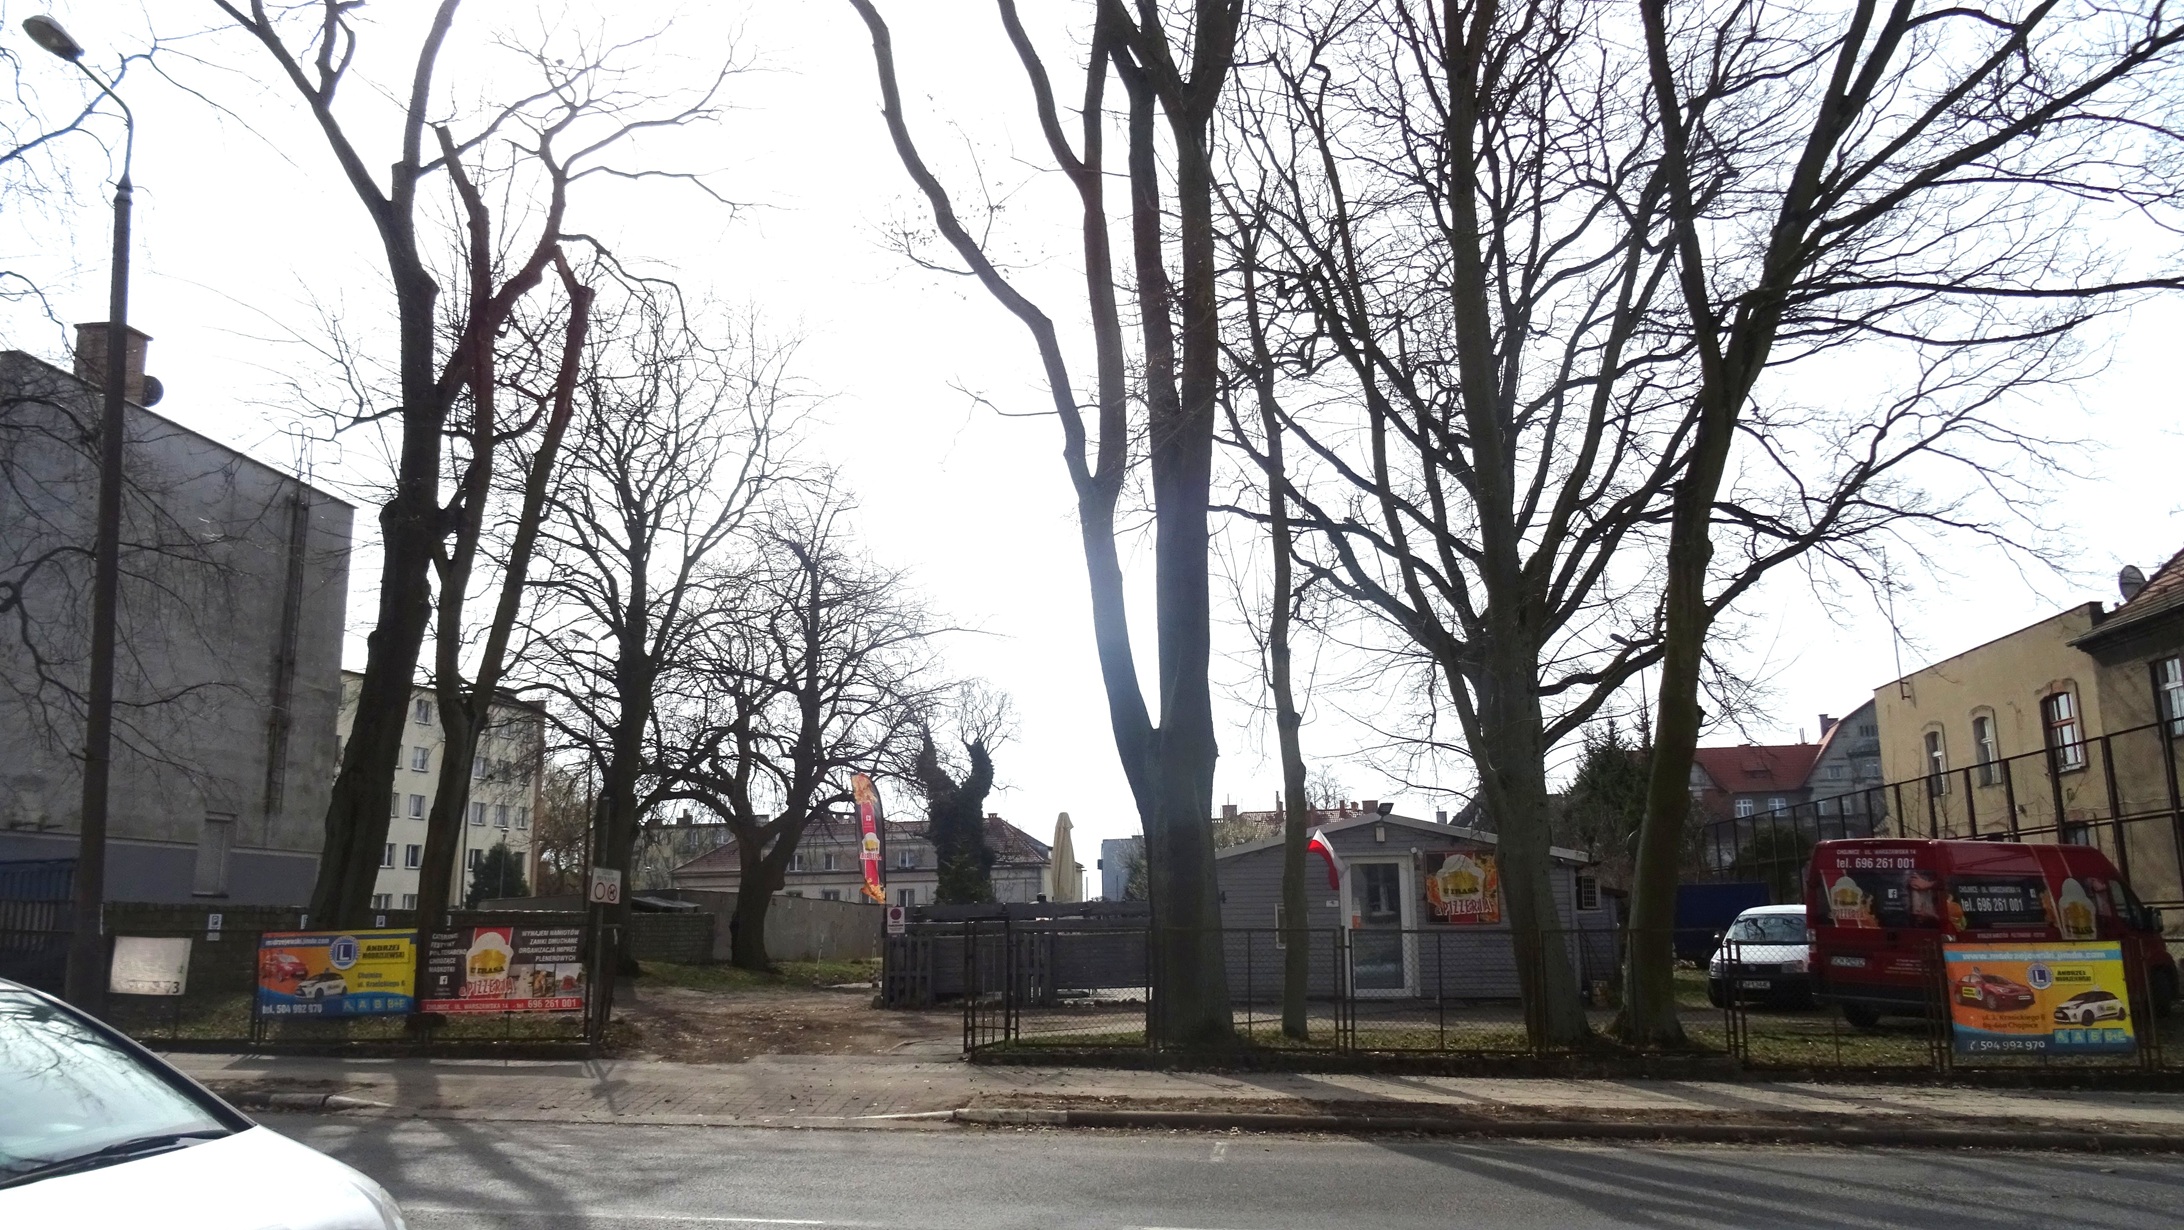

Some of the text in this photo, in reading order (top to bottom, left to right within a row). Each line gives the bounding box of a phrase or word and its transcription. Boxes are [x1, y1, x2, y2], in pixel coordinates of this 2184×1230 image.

[1836, 858, 1915, 868] tel. 696 261 001
[1442, 898, 1493, 916] PIZZERIA
[1961, 898, 1975, 911] tel.
[1977, 897, 1992, 911] 696
[1993, 897, 2007, 911] 261
[2009, 897, 2024, 911] 001
[341, 945, 350, 961] L
[518, 946, 555, 954] ORGANIZACJA
[2035, 970, 2045, 982] L
[466, 977, 516, 997] PIZZERIA
[262, 1004, 323, 1014] tel. 504 992 970
[527, 1000, 543, 1009] 696
[544, 999, 559, 1008] 261
[561, 998, 576, 1008] 001
[1980, 1040, 2046, 1050] 504 992 970
